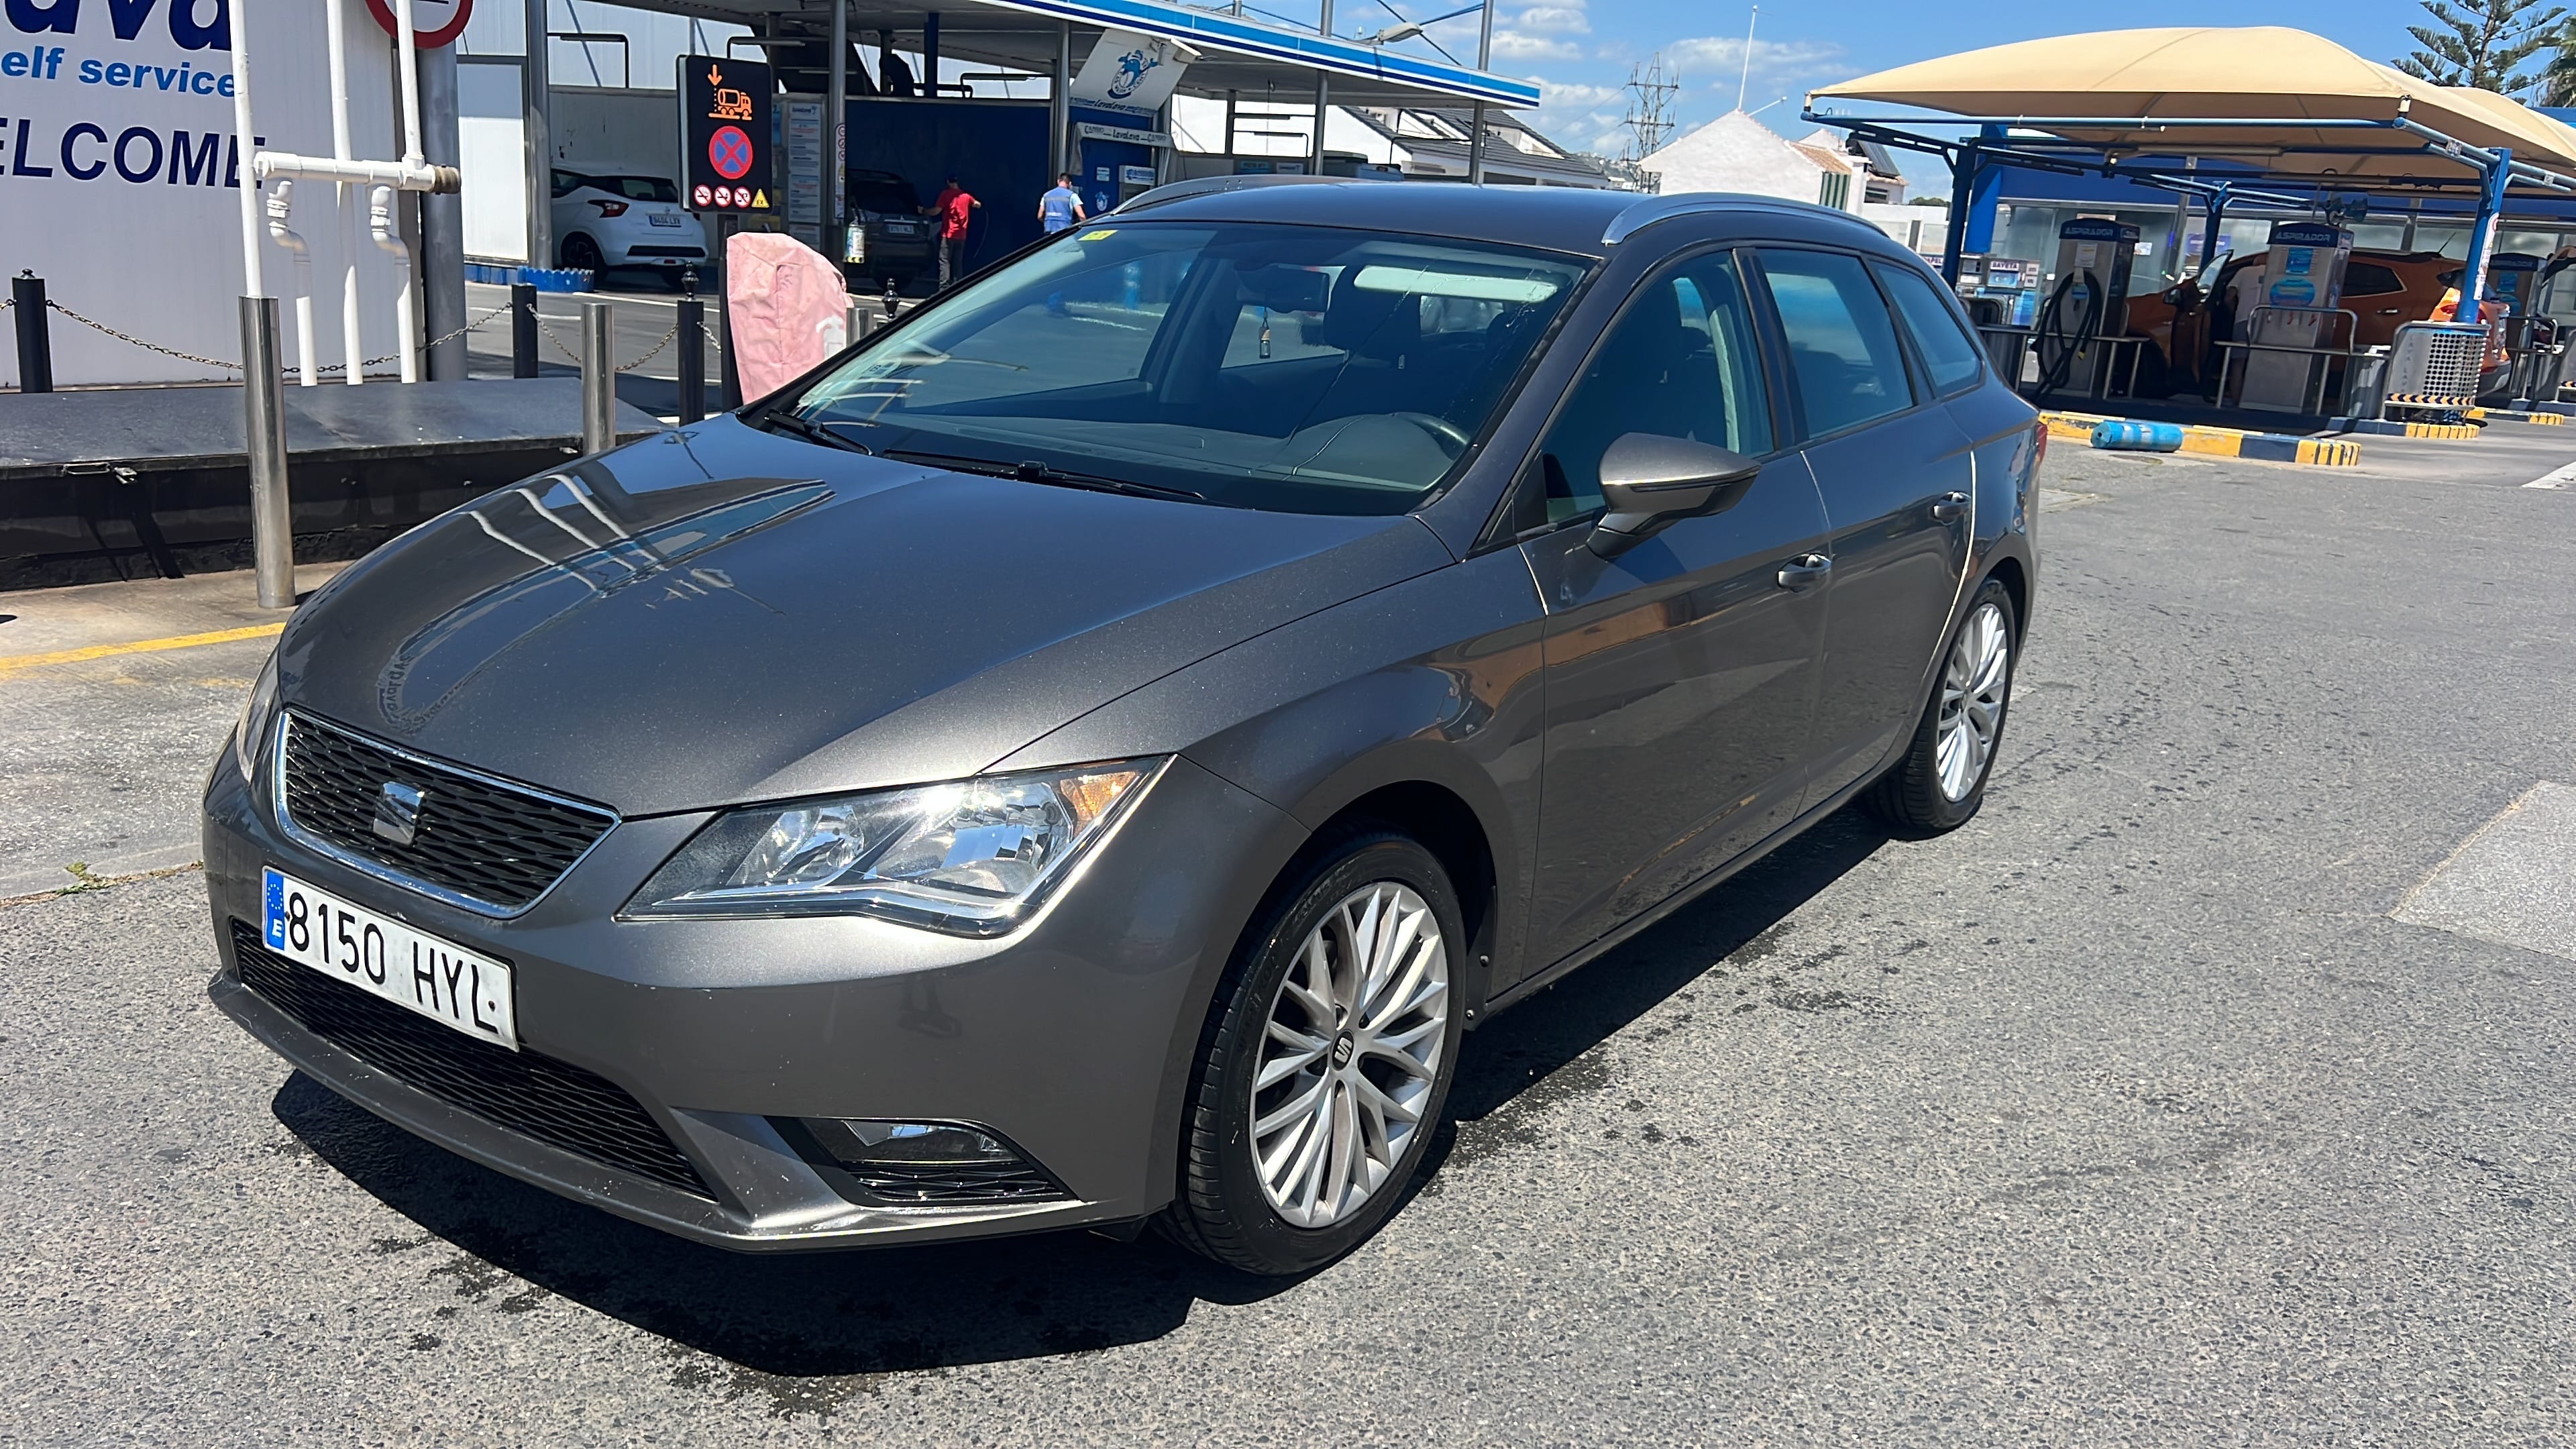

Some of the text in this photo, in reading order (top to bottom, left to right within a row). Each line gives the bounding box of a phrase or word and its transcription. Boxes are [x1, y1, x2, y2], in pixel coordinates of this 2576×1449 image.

[1, 46, 235, 97] elf service
[0, 117, 266, 189] LCOME
[2275, 232, 2331, 241] ASPIRADOR
[272, 919, 283, 938] E
[289, 892, 498, 1034] 8150 HYL
